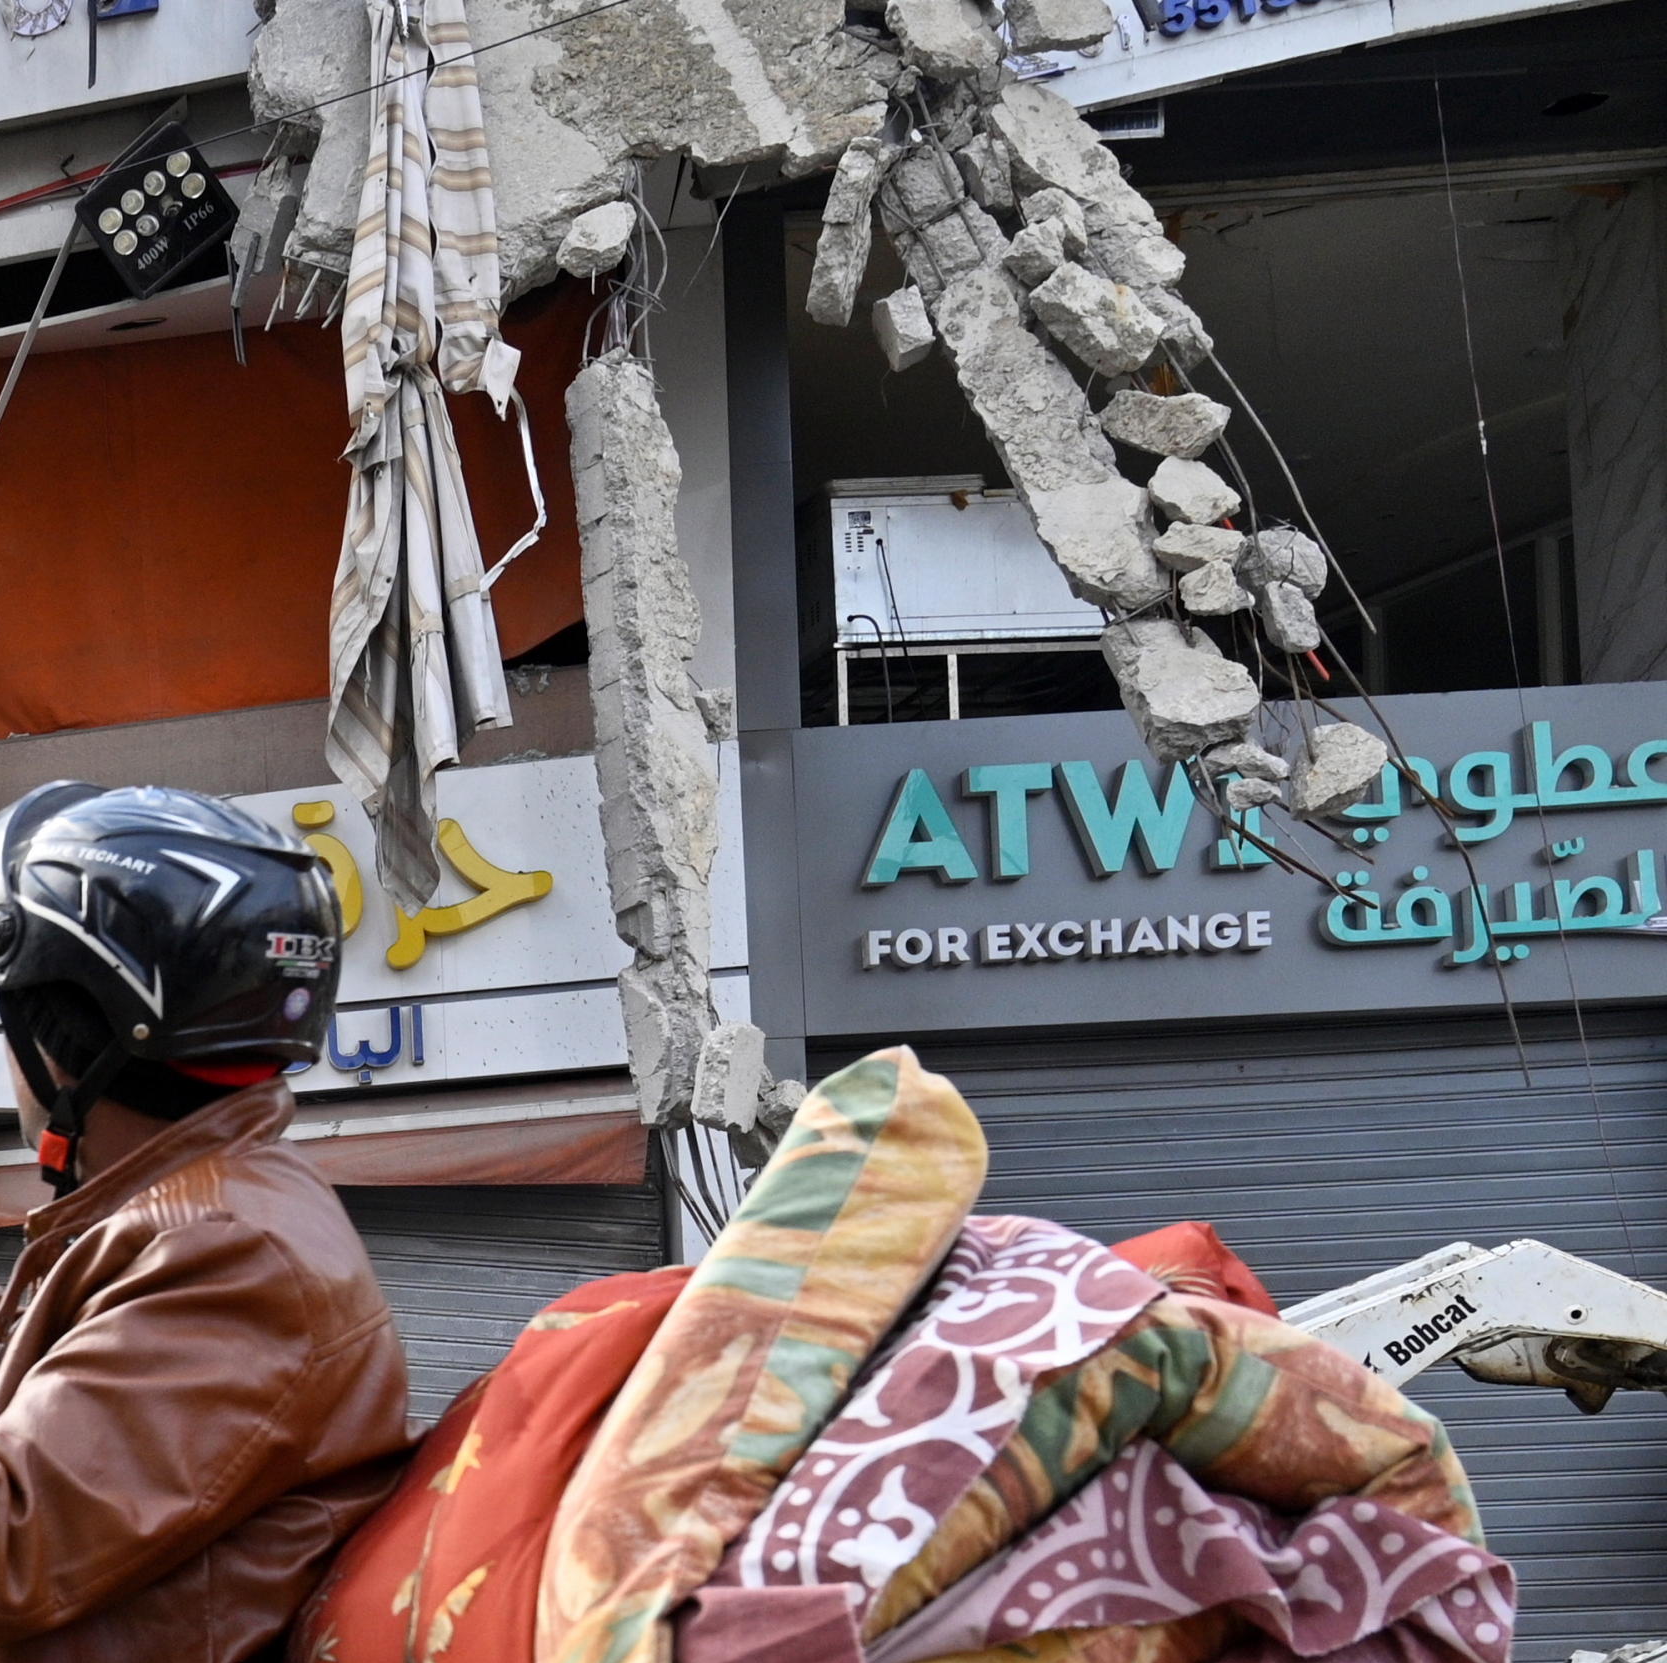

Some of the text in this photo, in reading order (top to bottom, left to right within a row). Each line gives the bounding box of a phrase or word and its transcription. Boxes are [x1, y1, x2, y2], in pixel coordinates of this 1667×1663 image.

[137, 202, 215, 270] 400W IP66
[863, 910, 1273, 969] FOR EXCHANGE
[1382, 1292, 1479, 1367] Bobcat
